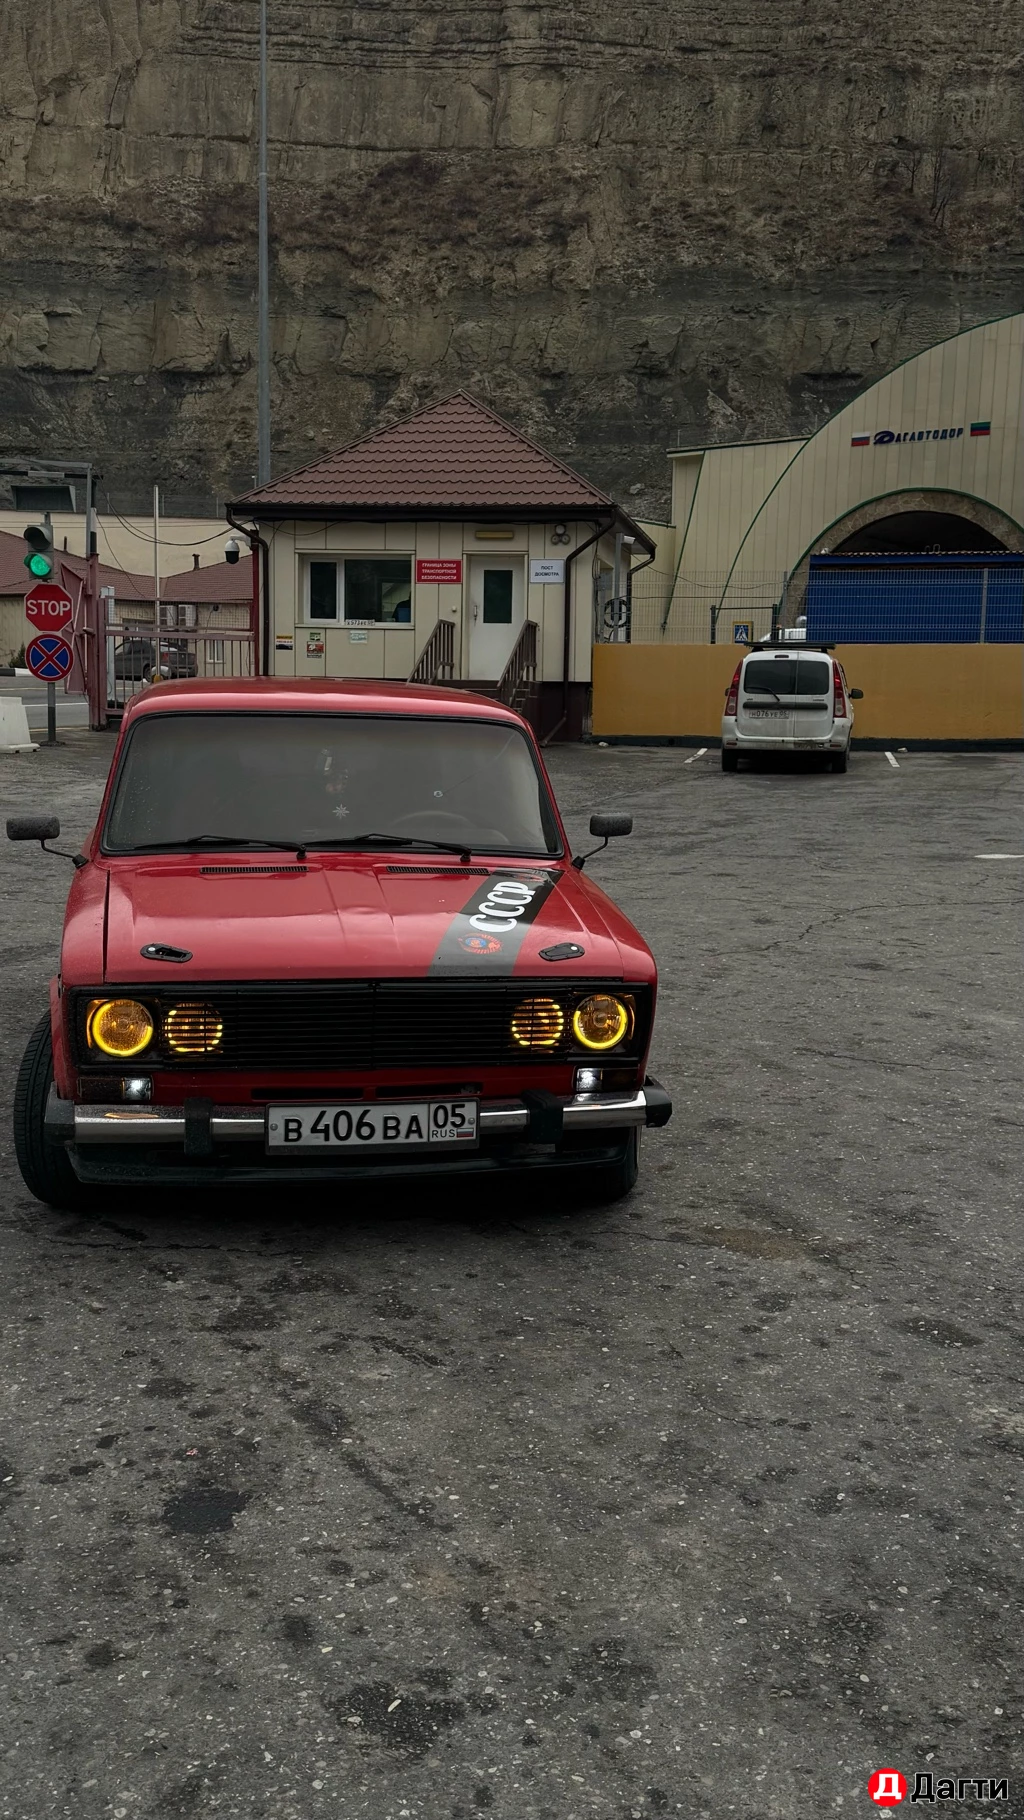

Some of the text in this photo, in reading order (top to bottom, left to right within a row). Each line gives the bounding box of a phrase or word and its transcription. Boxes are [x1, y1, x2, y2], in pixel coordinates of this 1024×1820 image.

[27, 599, 71, 616] STOP
[468, 881, 536, 933] СССР
[432, 1103, 466, 1129] 05
[431, 1129, 456, 1139] RUS
